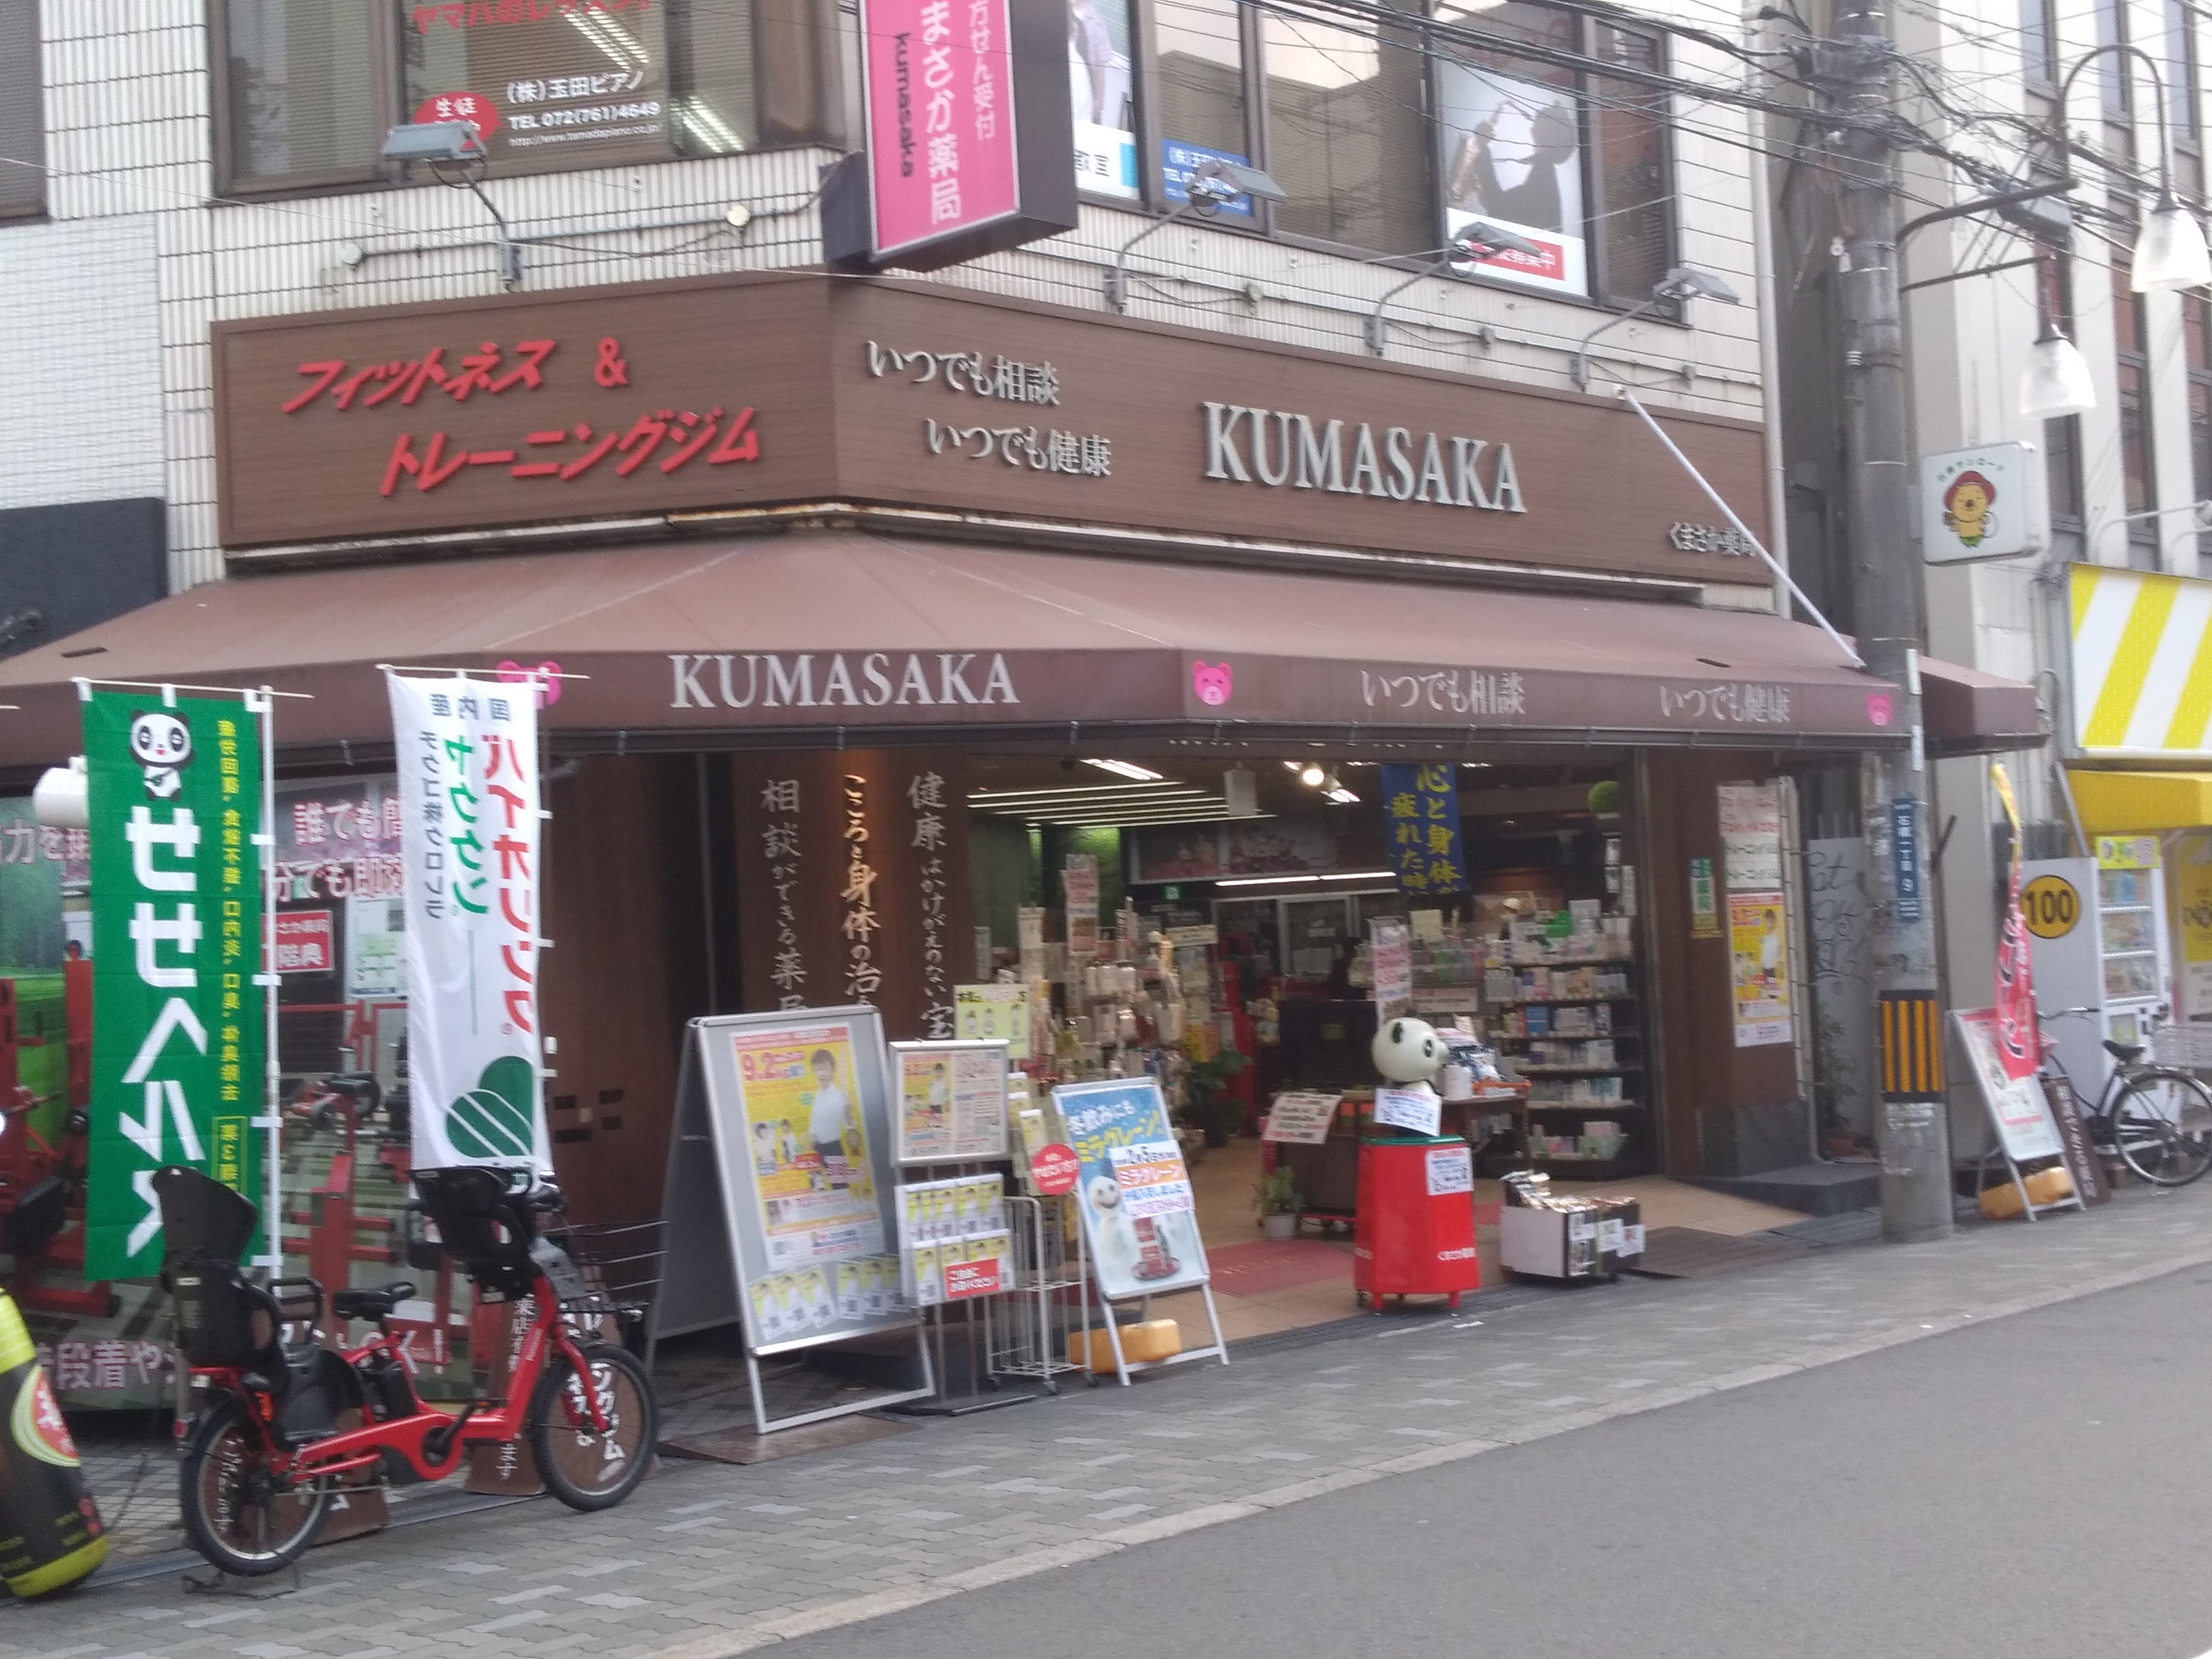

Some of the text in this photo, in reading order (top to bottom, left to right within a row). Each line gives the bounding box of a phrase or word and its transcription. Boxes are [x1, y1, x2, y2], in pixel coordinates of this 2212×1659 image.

[507, 115, 541, 130] TEL
[281, 336, 629, 414] フィットネス &
[867, 340, 1061, 406] いつでも相談
[379, 406, 759, 497] トレーニングジム
[925, 416, 1112, 478] いつでも健康
[1203, 401, 1528, 514] KUMASAKA
[667, 652, 1021, 709] KUMASAKA
[1360, 669, 1526, 715] いつでも相談
[1659, 683, 1790, 724] いつでも健康
[839, 774, 882, 1005] こころと身体の治
[2023, 889, 2073, 925] 100
